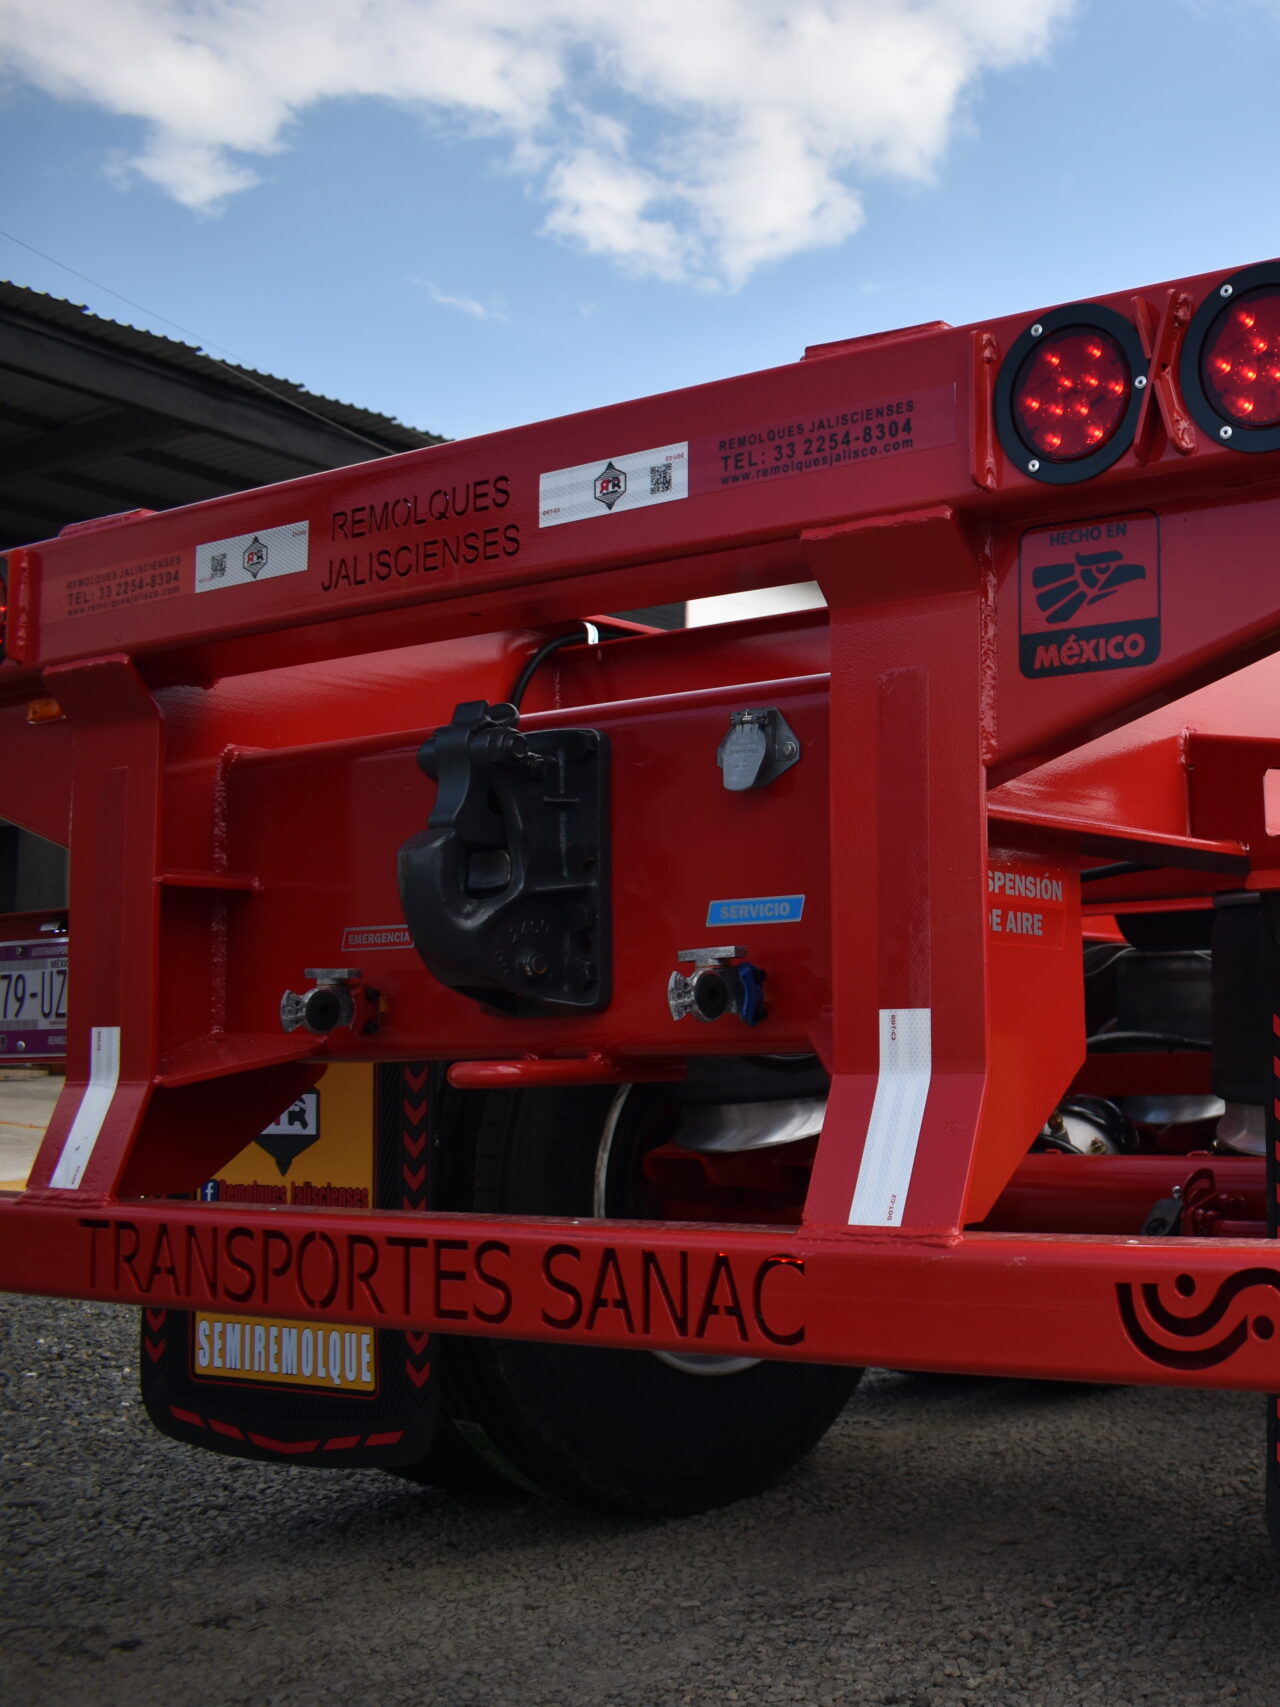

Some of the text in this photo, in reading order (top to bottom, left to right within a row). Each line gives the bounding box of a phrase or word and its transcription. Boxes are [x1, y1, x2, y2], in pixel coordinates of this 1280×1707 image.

[719, 400, 914, 451] REMOLQUES JALISCIENSES
[721, 418, 912, 472] TEL: 33 2254-8304
[720, 438, 914, 486] www.remolquesjalisco.com
[331, 475, 511, 543] REMOLQUES
[1050, 522, 1127, 547] HECHO EN
[321, 524, 521, 592] JALISCIENSES
[720, 901, 791, 920] SERVICIO
[988, 908, 1043, 936] E AIRE
[348, 931, 410, 945] EMERGENCIA
[78, 1218, 806, 1346] TRANSPORTES SANAC
[199, 1320, 372, 1385] SEMIREMOLQUE
